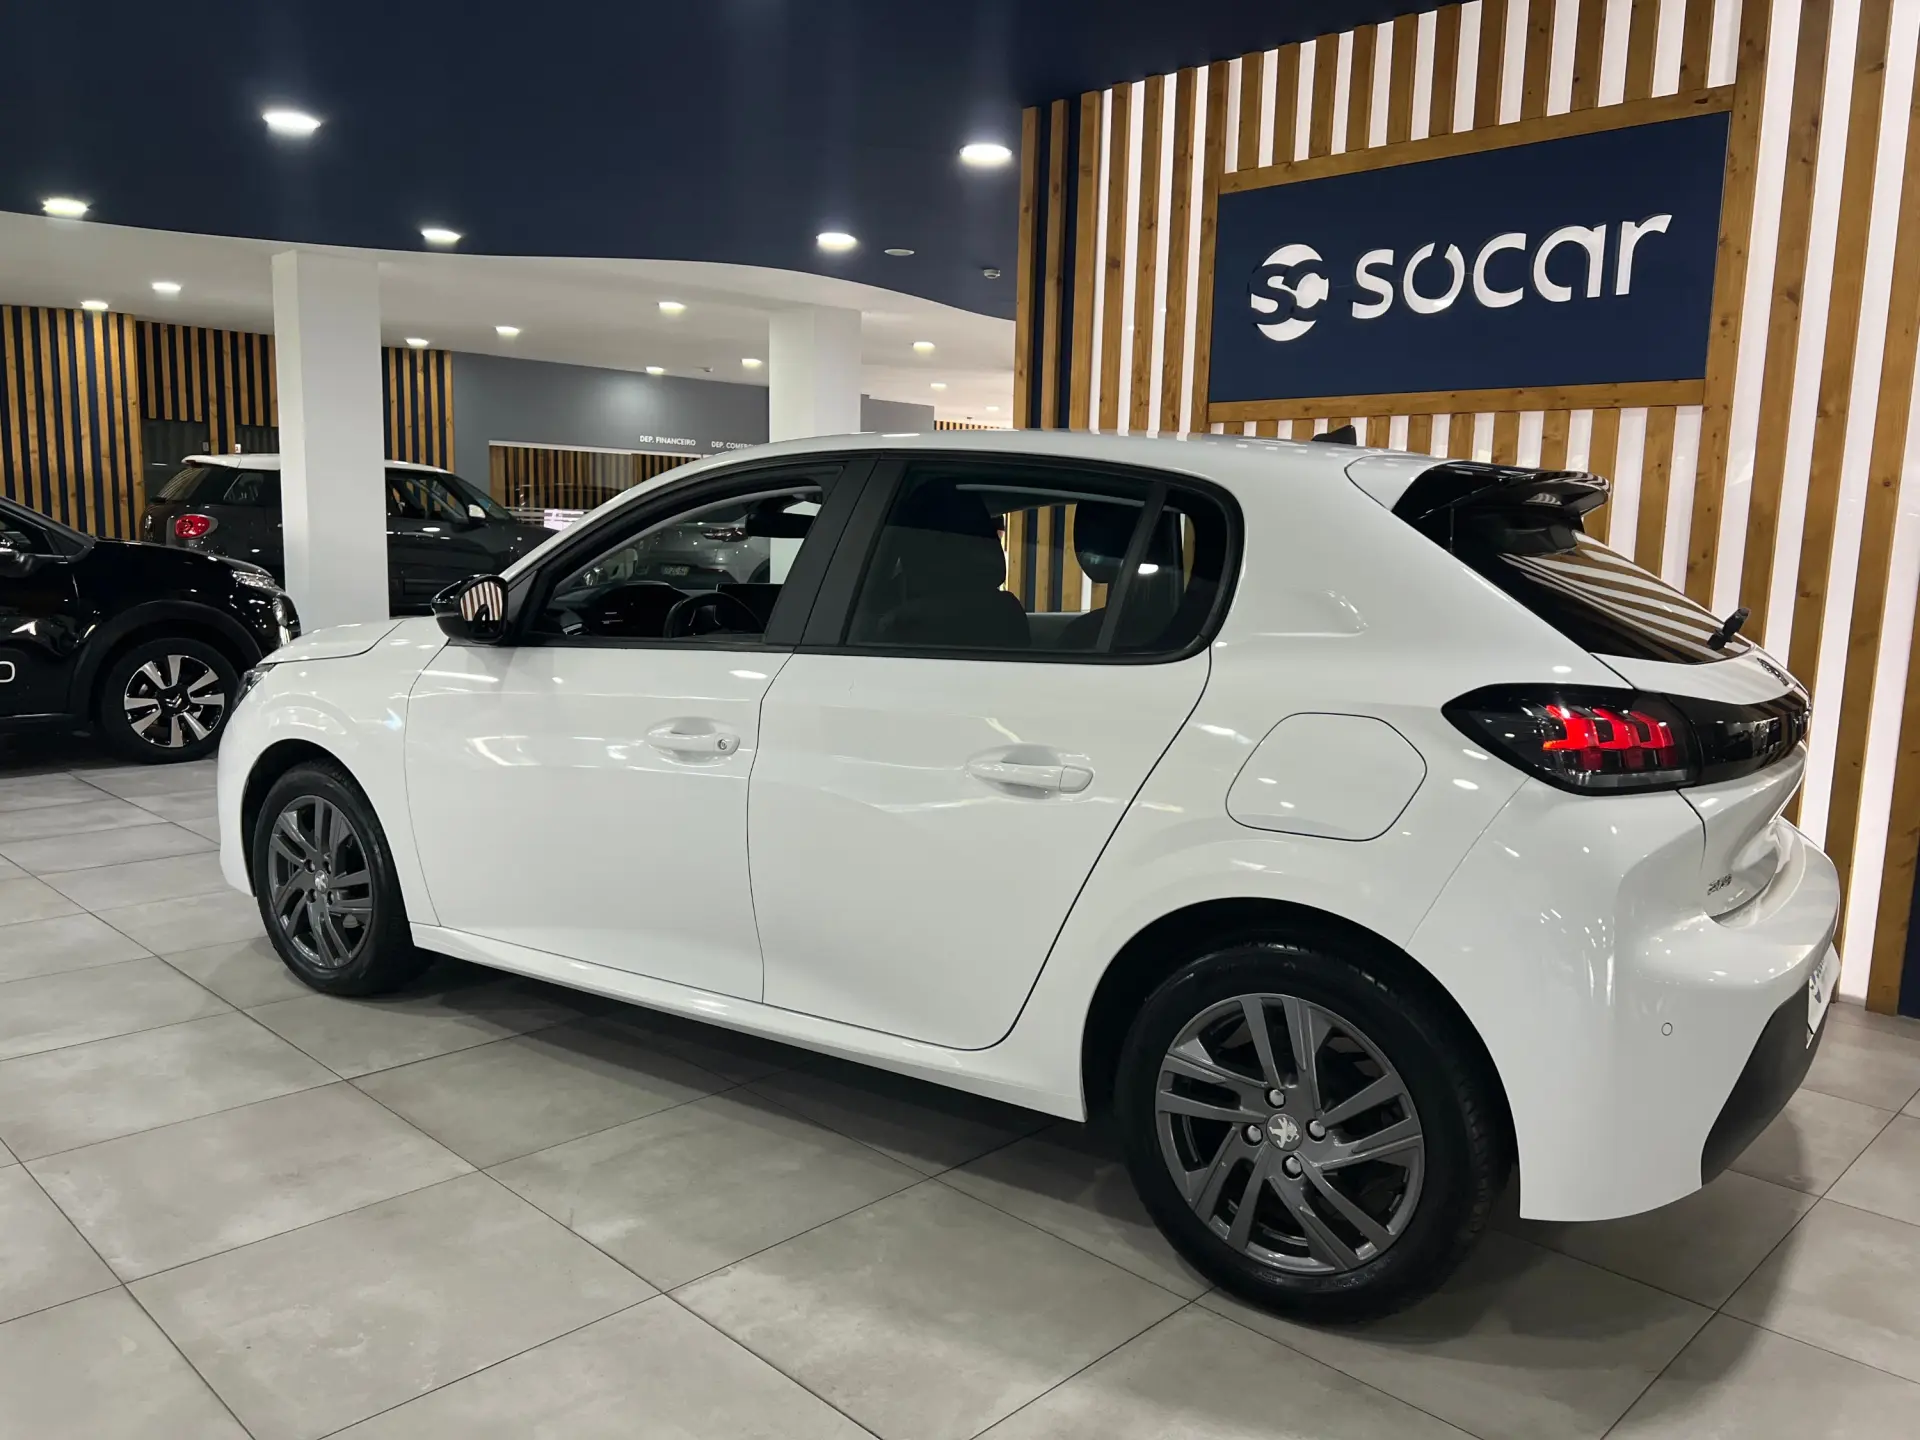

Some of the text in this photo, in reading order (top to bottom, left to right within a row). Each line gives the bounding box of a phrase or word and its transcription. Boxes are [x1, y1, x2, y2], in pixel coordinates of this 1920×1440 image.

[1351, 214, 1673, 320] socar
[639, 435, 696, 446] DEP. FINANCEIRO
[711, 440, 725, 449] DEP.
